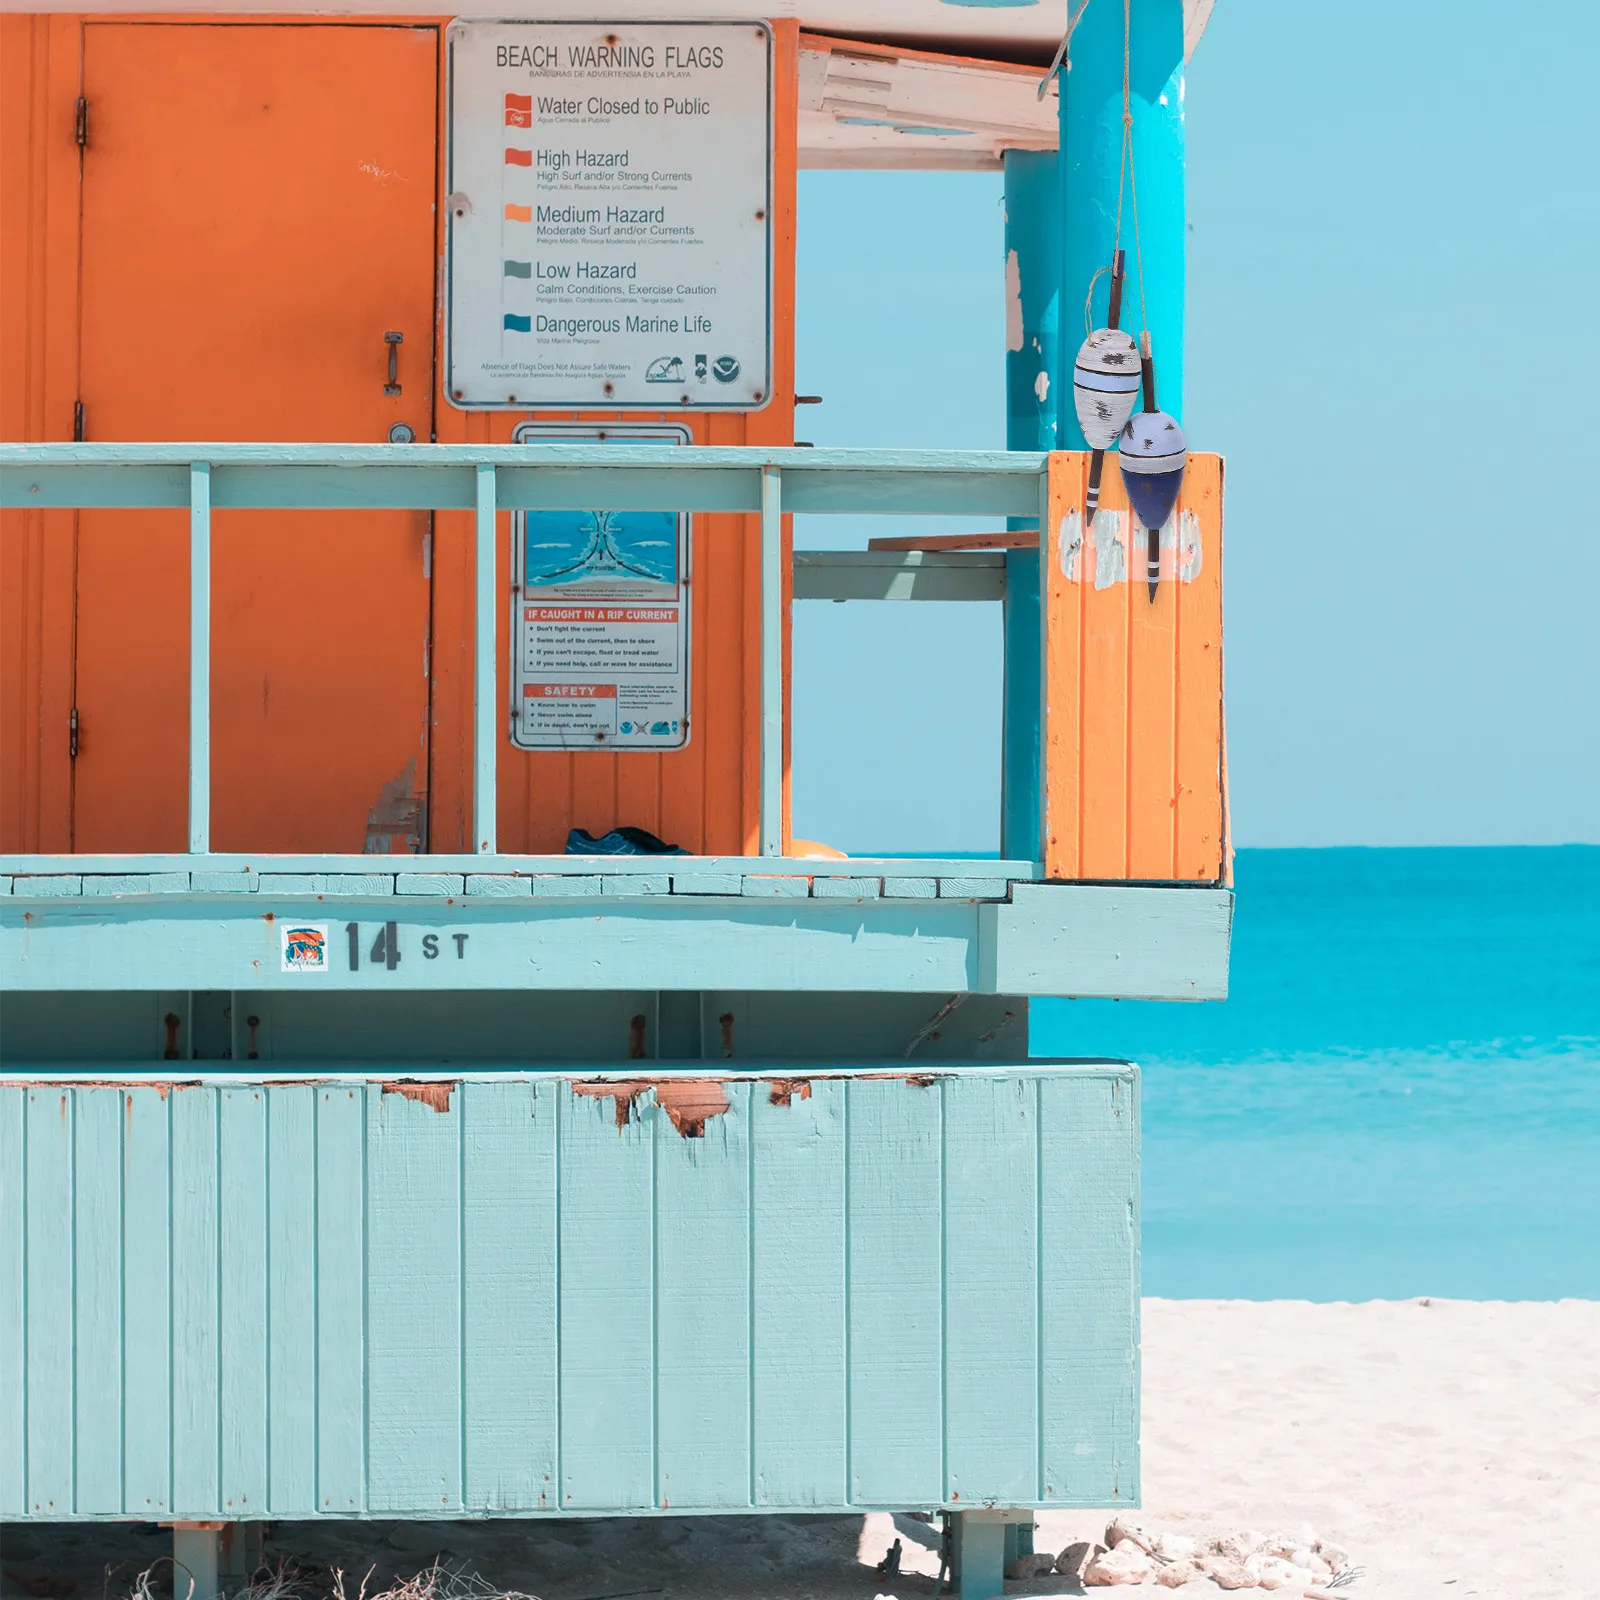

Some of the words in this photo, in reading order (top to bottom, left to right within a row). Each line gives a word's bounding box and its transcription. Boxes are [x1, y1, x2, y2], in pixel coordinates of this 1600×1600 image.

[497, 46, 557, 69] BEACH
[569, 46, 654, 69] WARNING
[666, 46, 724, 69] FLAGS
[538, 97, 582, 115] Water
[587, 97, 640, 115] Closed
[645, 97, 659, 115] to
[664, 97, 710, 115] Public
[537, 150, 570, 170] High
[576, 150, 629, 167] Hazard
[537, 171, 559, 183] High
[562, 171, 581, 181] Surf
[585, 171, 614, 181] and/or
[618, 171, 649, 183] Strong
[651, 171, 693, 181] Currents
[537, 206, 601, 223] Medium
[607, 206, 665, 223] Hazard
[537, 226, 586, 235] Moderate
[590, 226, 611, 235] Surf
[614, 226, 647, 235] and/or
[650, 226, 695, 235] Currents
[536, 262, 571, 279] Low
[577, 262, 637, 279] Hazard
[537, 284, 564, 295] Calm
[567, 284, 625, 296] Conditions,
[629, 284, 673, 295] Exercise
[676, 284, 717, 295] Caution
[536, 315, 620, 337] Dangerous
[626, 315, 679, 333] Marine
[684, 315, 712, 333] Life
[519, 363, 537, 371] Flags
[528, 610, 538, 619] IF
[540, 610, 581, 619] CAUGHT
[584, 610, 594, 619] IN
[598, 610, 605, 619] A
[608, 610, 623, 619] RIP
[626, 611, 674, 620] CURRENT
[545, 687, 596, 696] SAFETY
[346, 921, 401, 971] 14
[422, 934, 469, 959] ST
